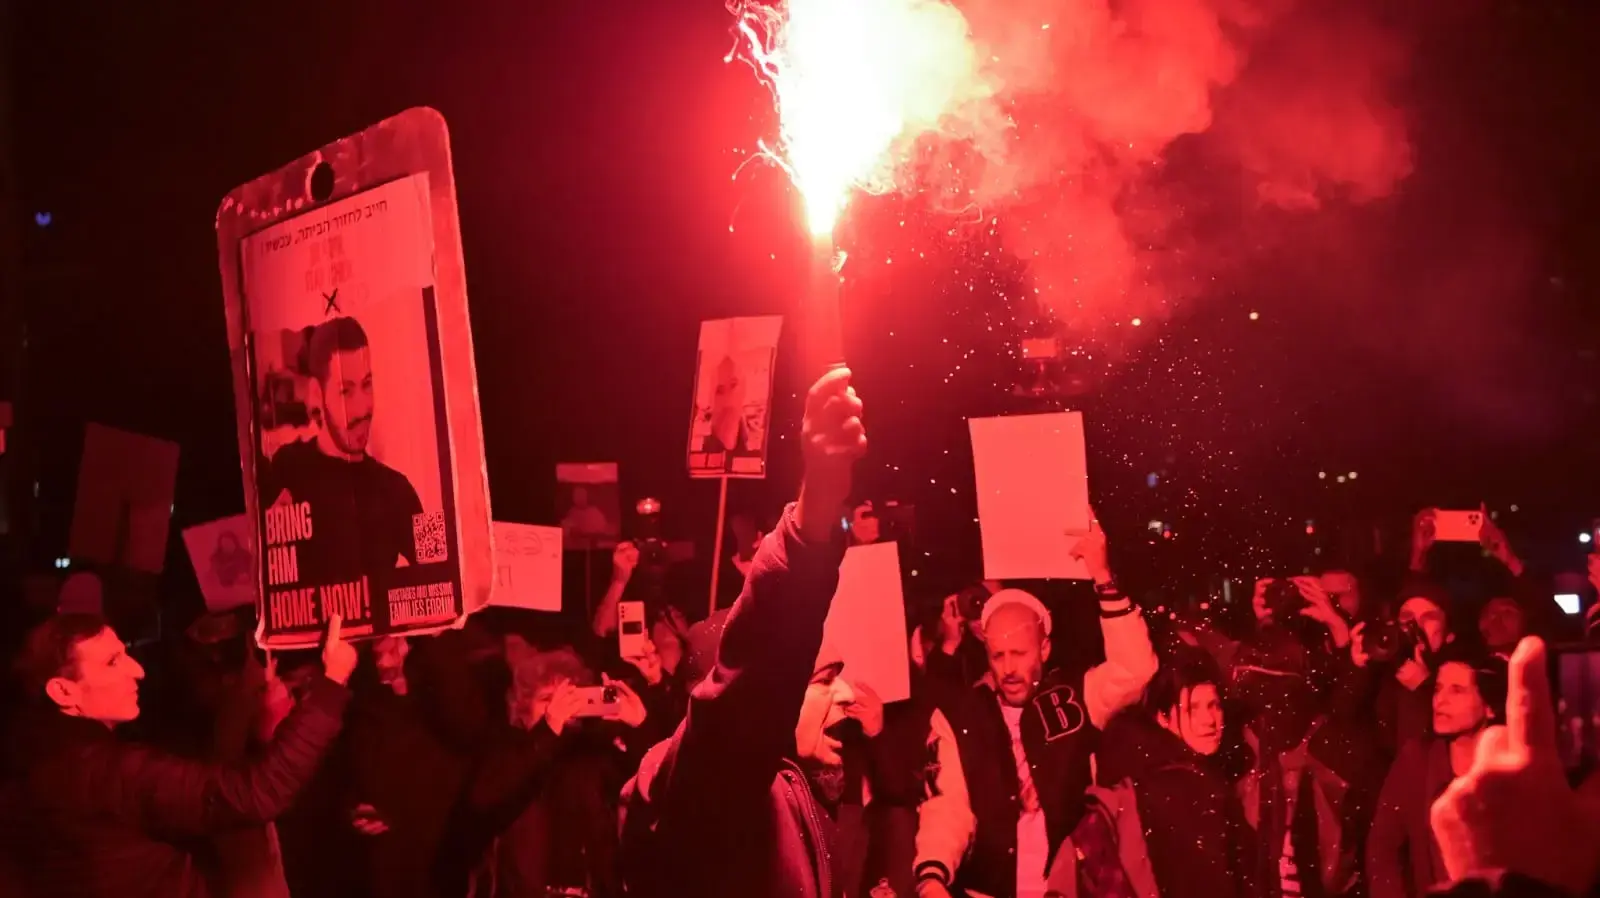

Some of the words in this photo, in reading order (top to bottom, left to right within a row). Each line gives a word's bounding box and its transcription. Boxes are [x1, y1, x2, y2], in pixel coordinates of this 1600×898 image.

[332, 208, 362, 229] לחזור
[365, 200, 388, 218] חייב
[265, 501, 313, 544] BRING
[268, 545, 299, 585] HIM
[270, 588, 318, 629] HOME
[319, 575, 371, 624] NOW!
[389, 599, 425, 621] FAMILIES
[1032, 685, 1084, 741] B
